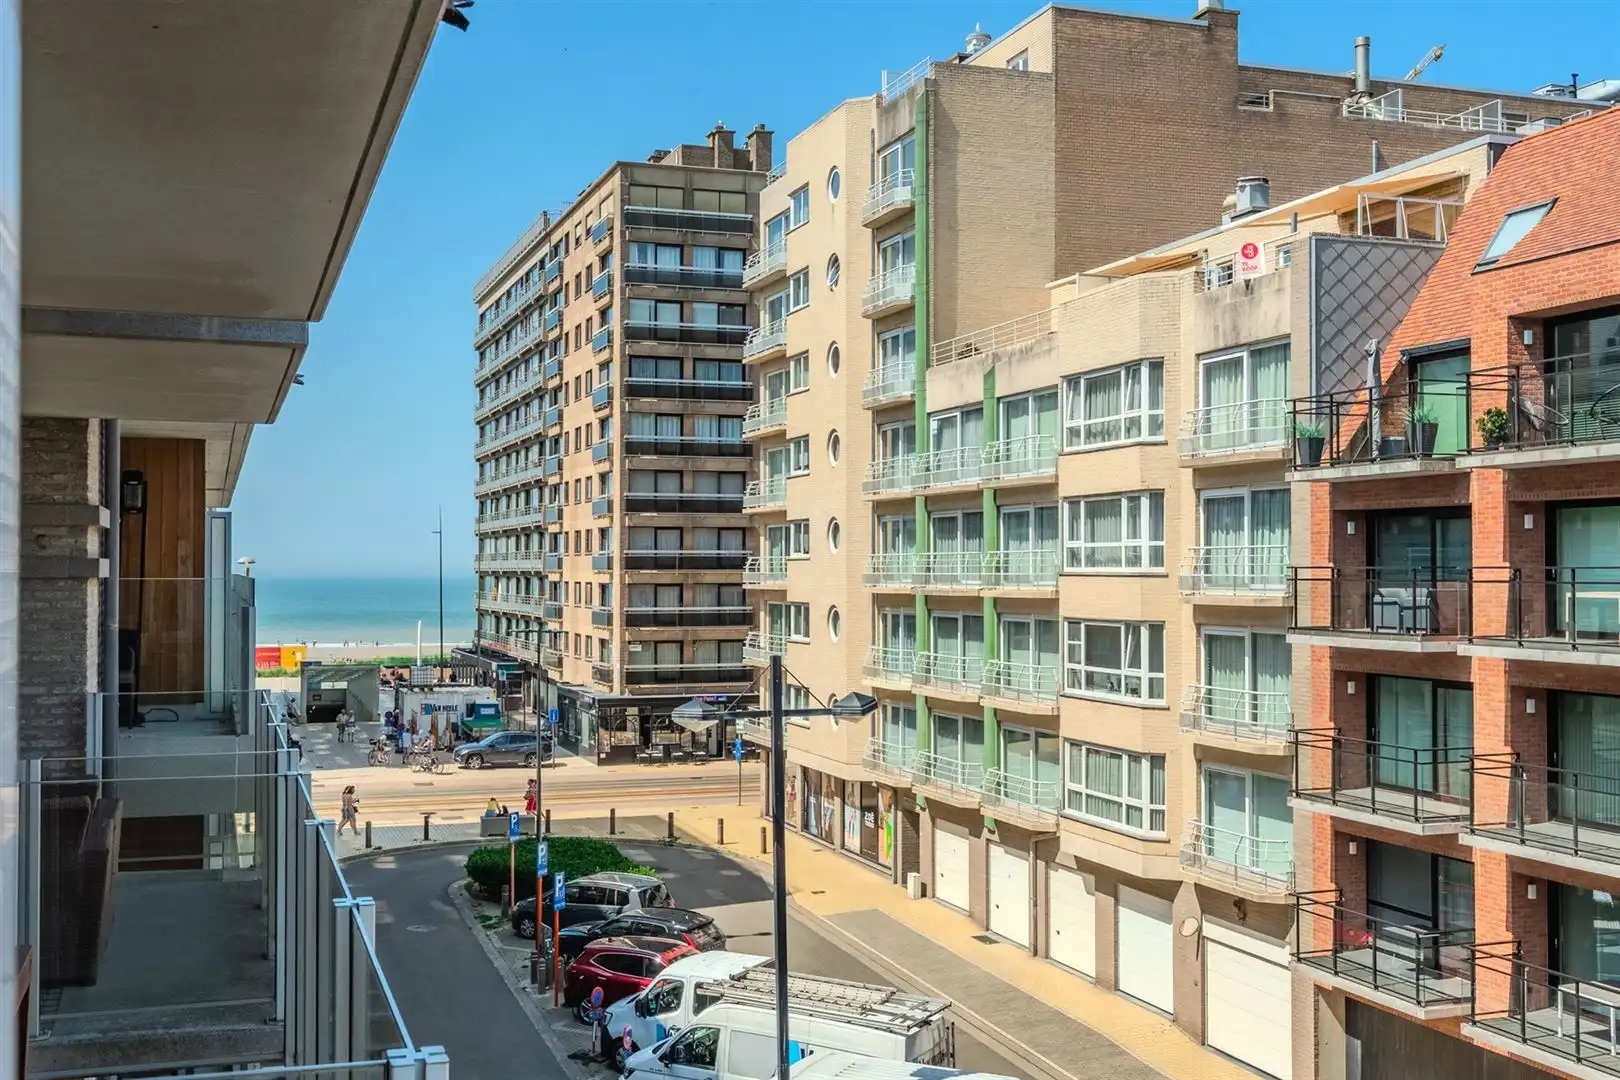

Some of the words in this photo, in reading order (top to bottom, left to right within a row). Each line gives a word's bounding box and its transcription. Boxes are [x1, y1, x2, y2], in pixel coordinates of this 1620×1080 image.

[511, 814, 517, 829] P
[539, 843, 546, 865] P
[555, 875, 563, 897] P
